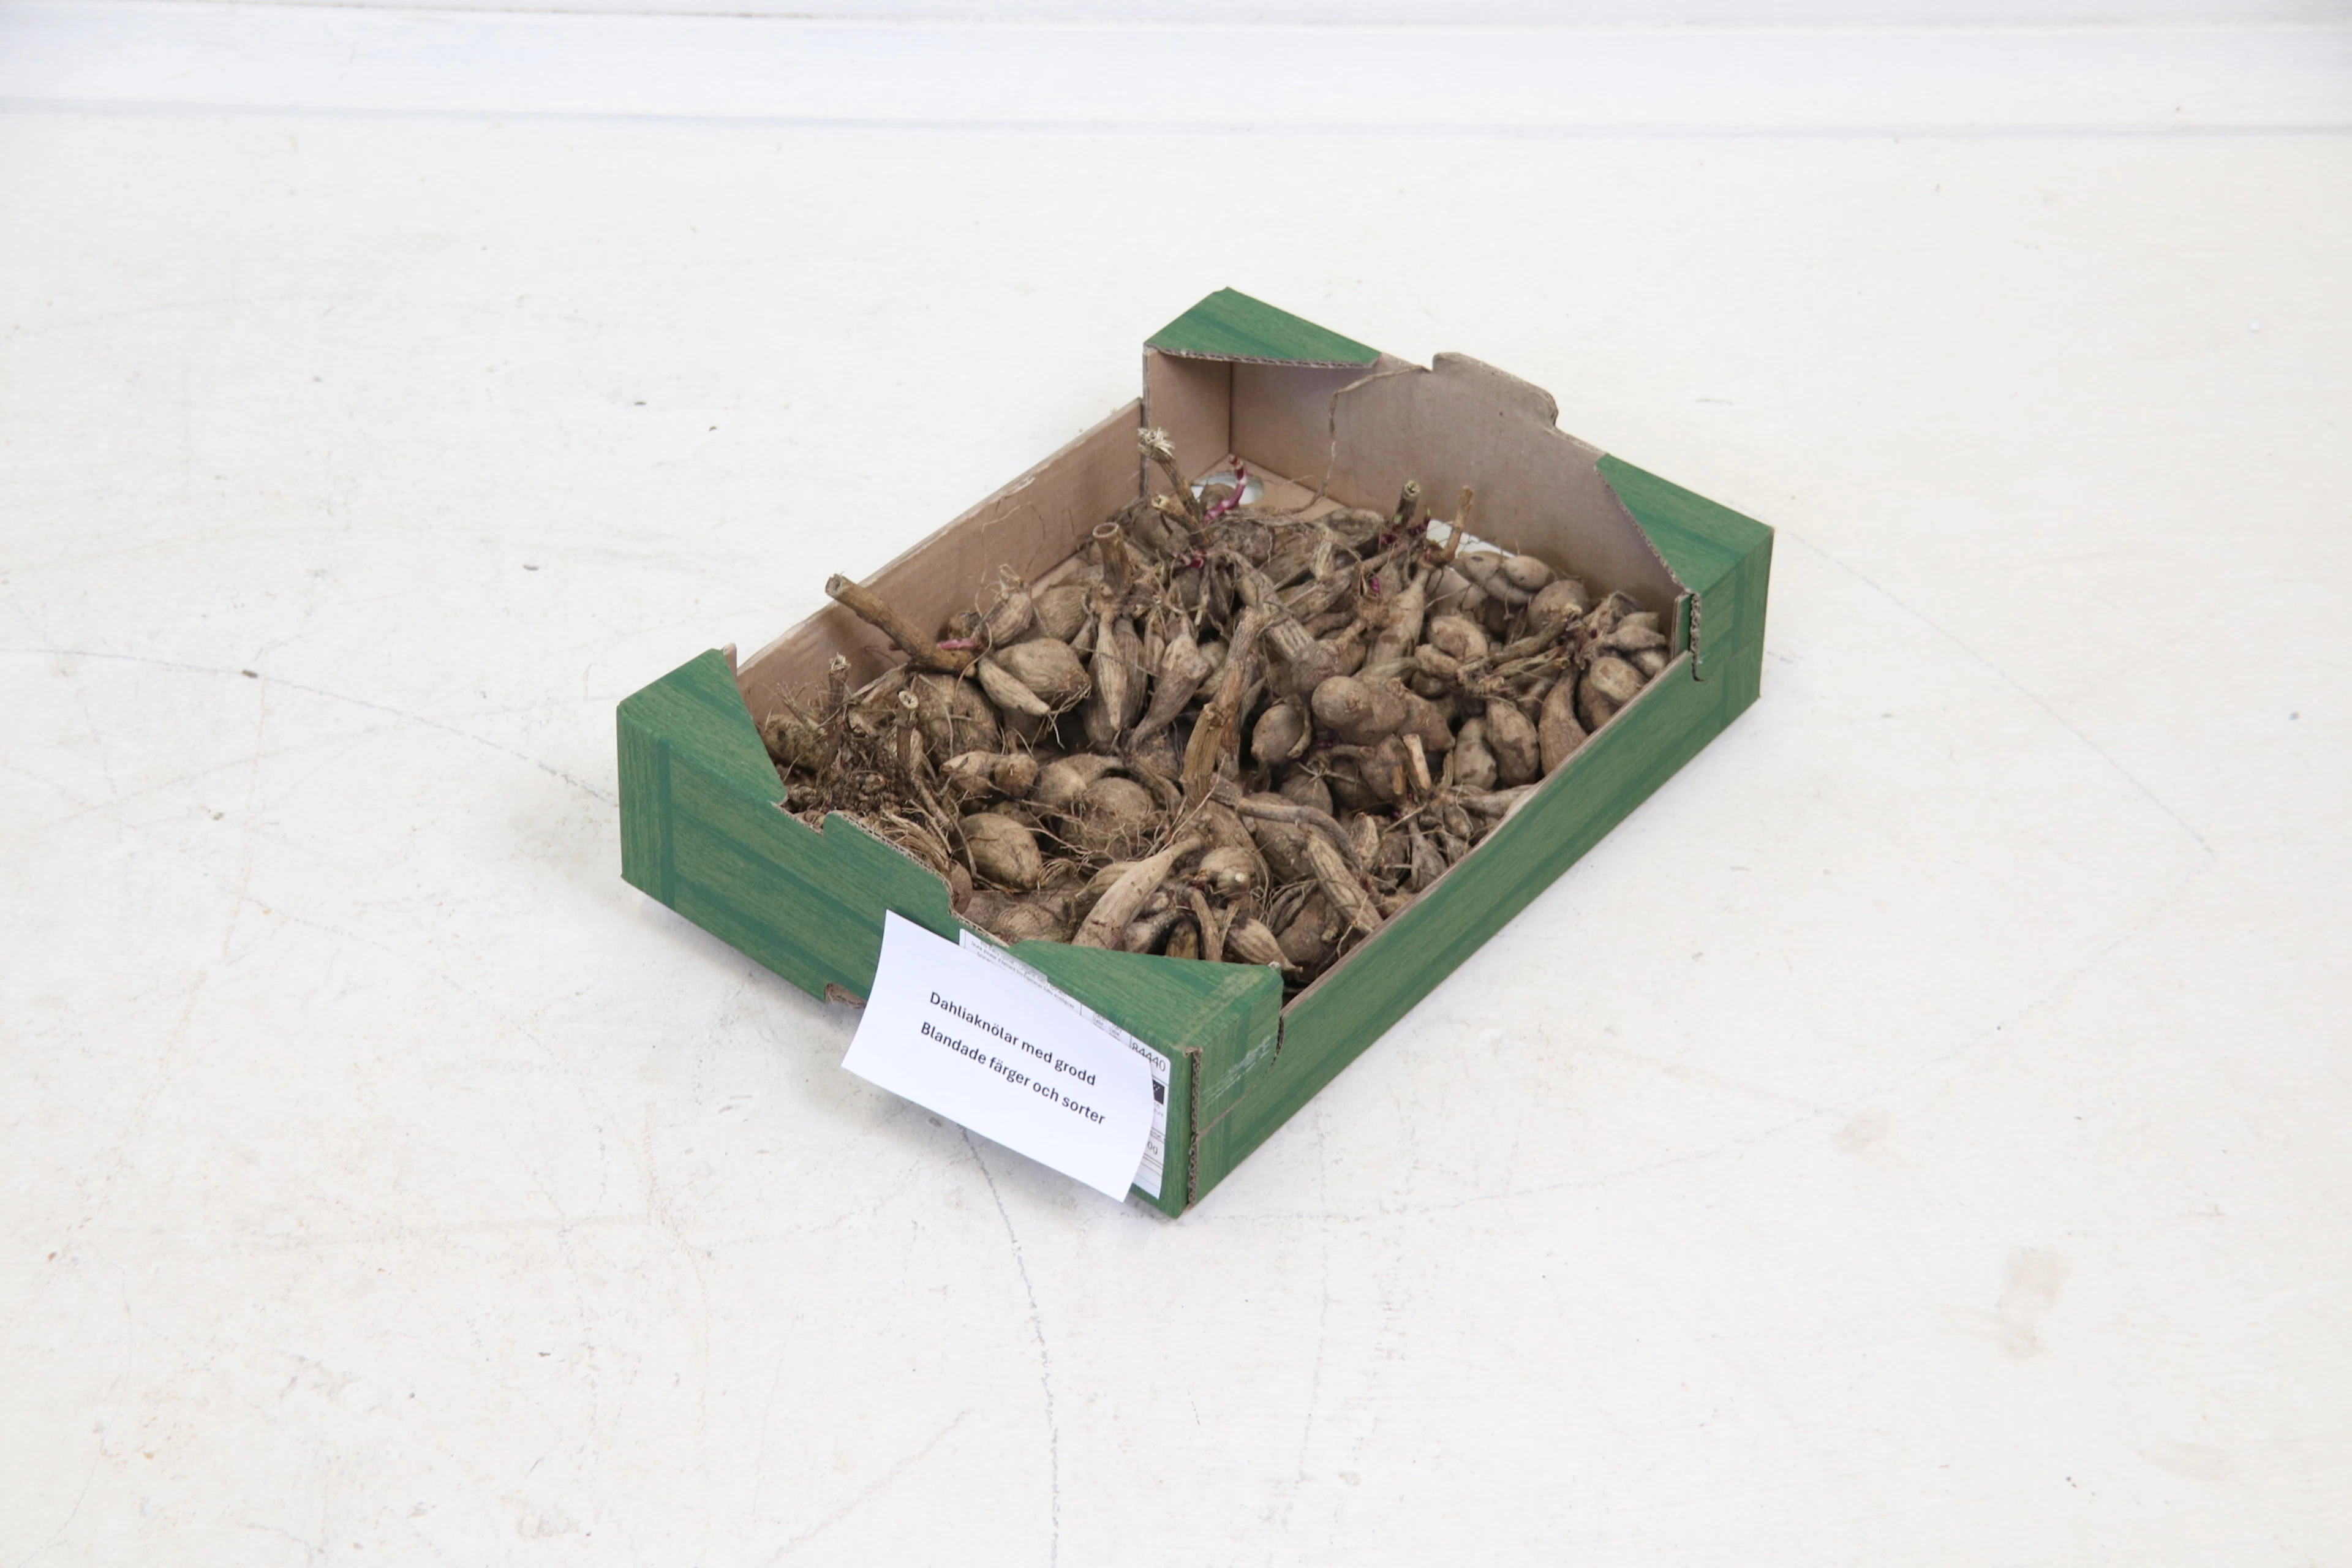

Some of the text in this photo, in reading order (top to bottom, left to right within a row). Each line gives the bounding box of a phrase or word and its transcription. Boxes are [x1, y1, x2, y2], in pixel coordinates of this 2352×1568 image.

[921, 1022, 1106, 1125] Blandade färger och sorter
[930, 991, 1096, 1087] Dahliaknölar med grodd
